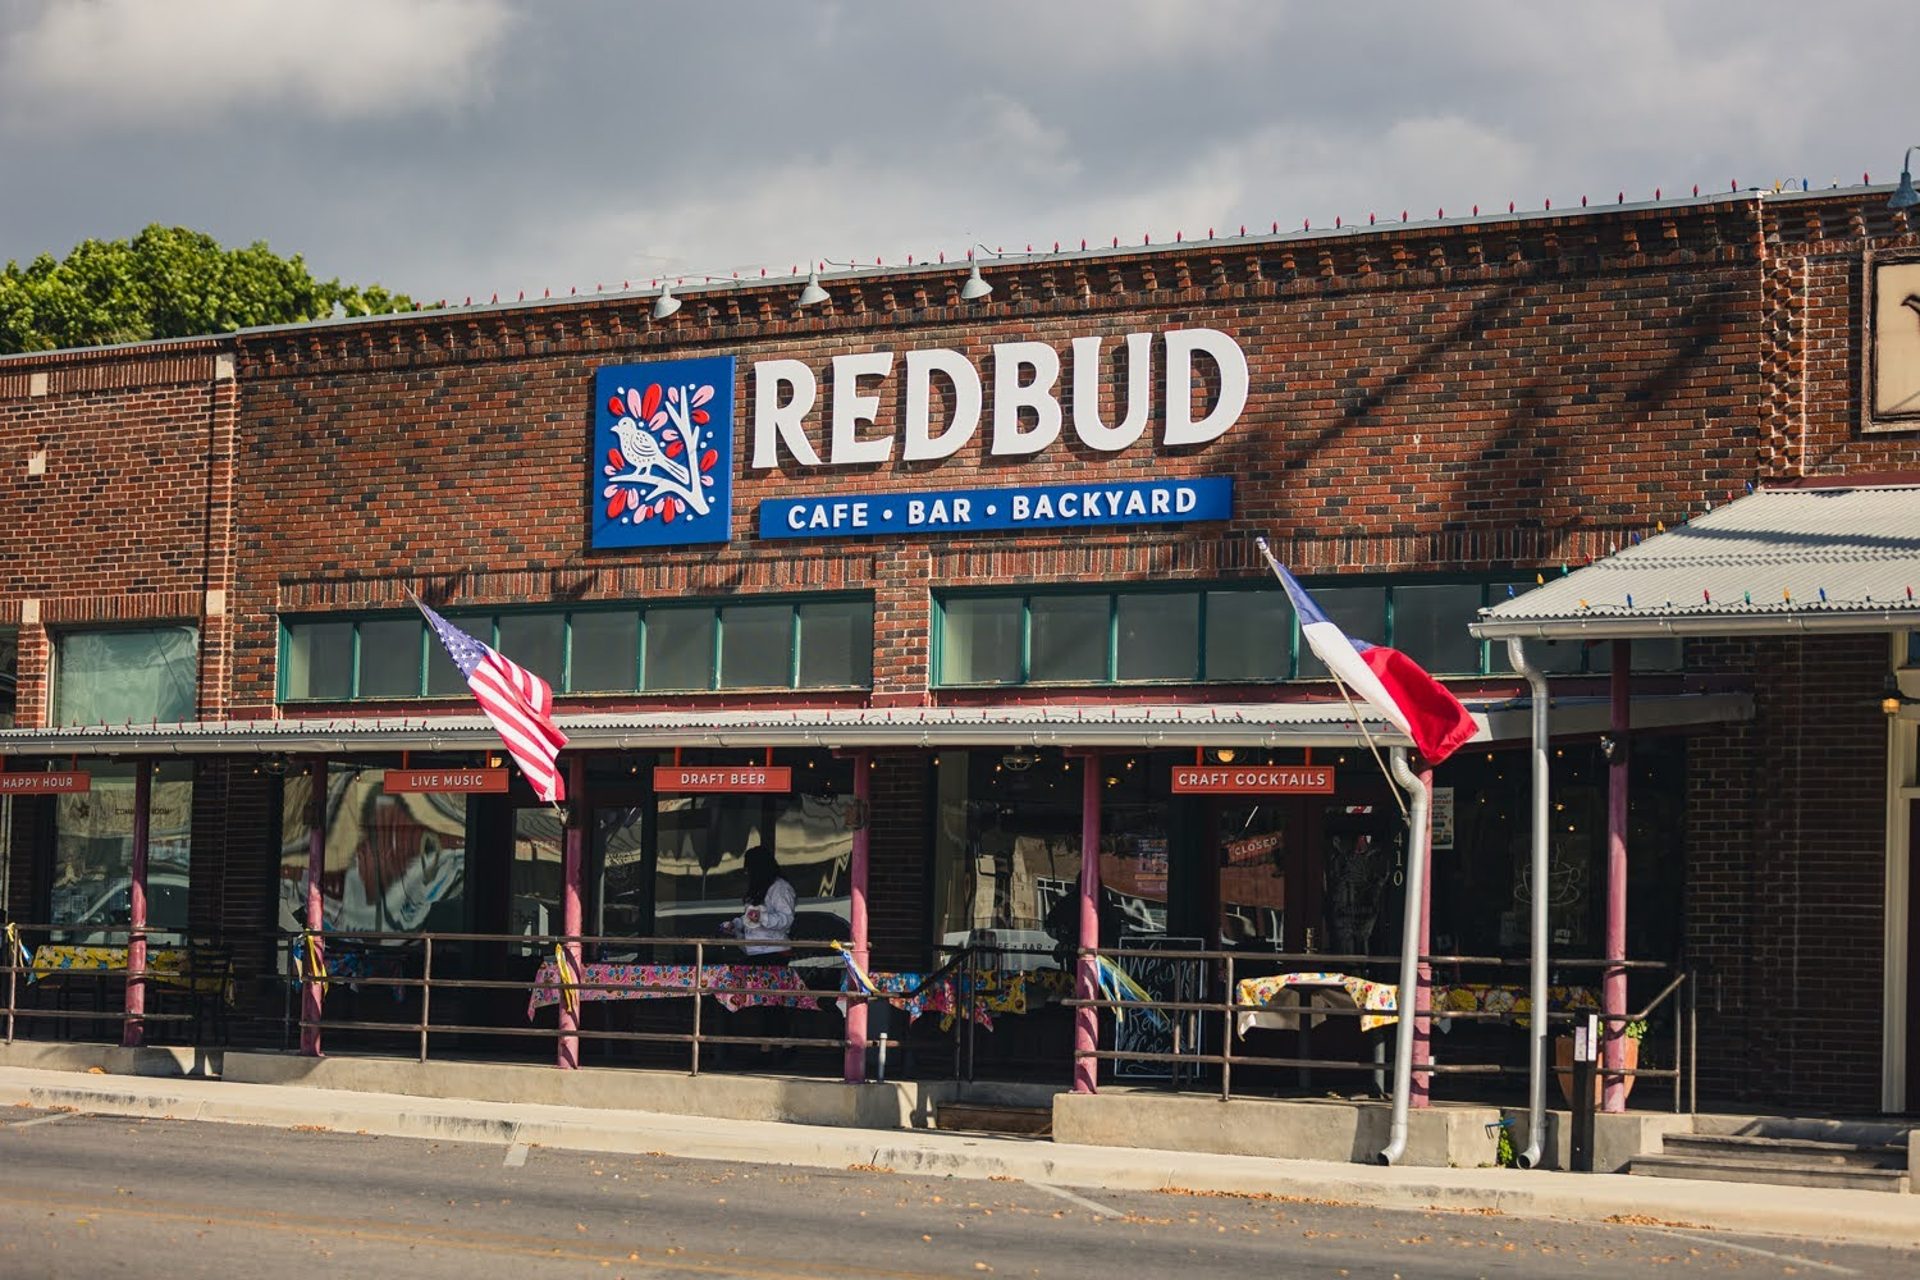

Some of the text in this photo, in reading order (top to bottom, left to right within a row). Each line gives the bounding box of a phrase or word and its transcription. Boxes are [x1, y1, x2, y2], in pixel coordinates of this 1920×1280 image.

[751, 328, 1249, 469] REDBUD
[788, 487, 1198, 530] CAFE BAR BACKYARD
[3, 777, 73, 788] HAPPY HOUR
[411, 775, 483, 787] LIVE MUSIC
[681, 773, 766, 784] DRAFT BEER
[1178, 773, 1326, 786] CRAFT COCKTAILS
[1234, 836, 1278, 856] CLOSED
